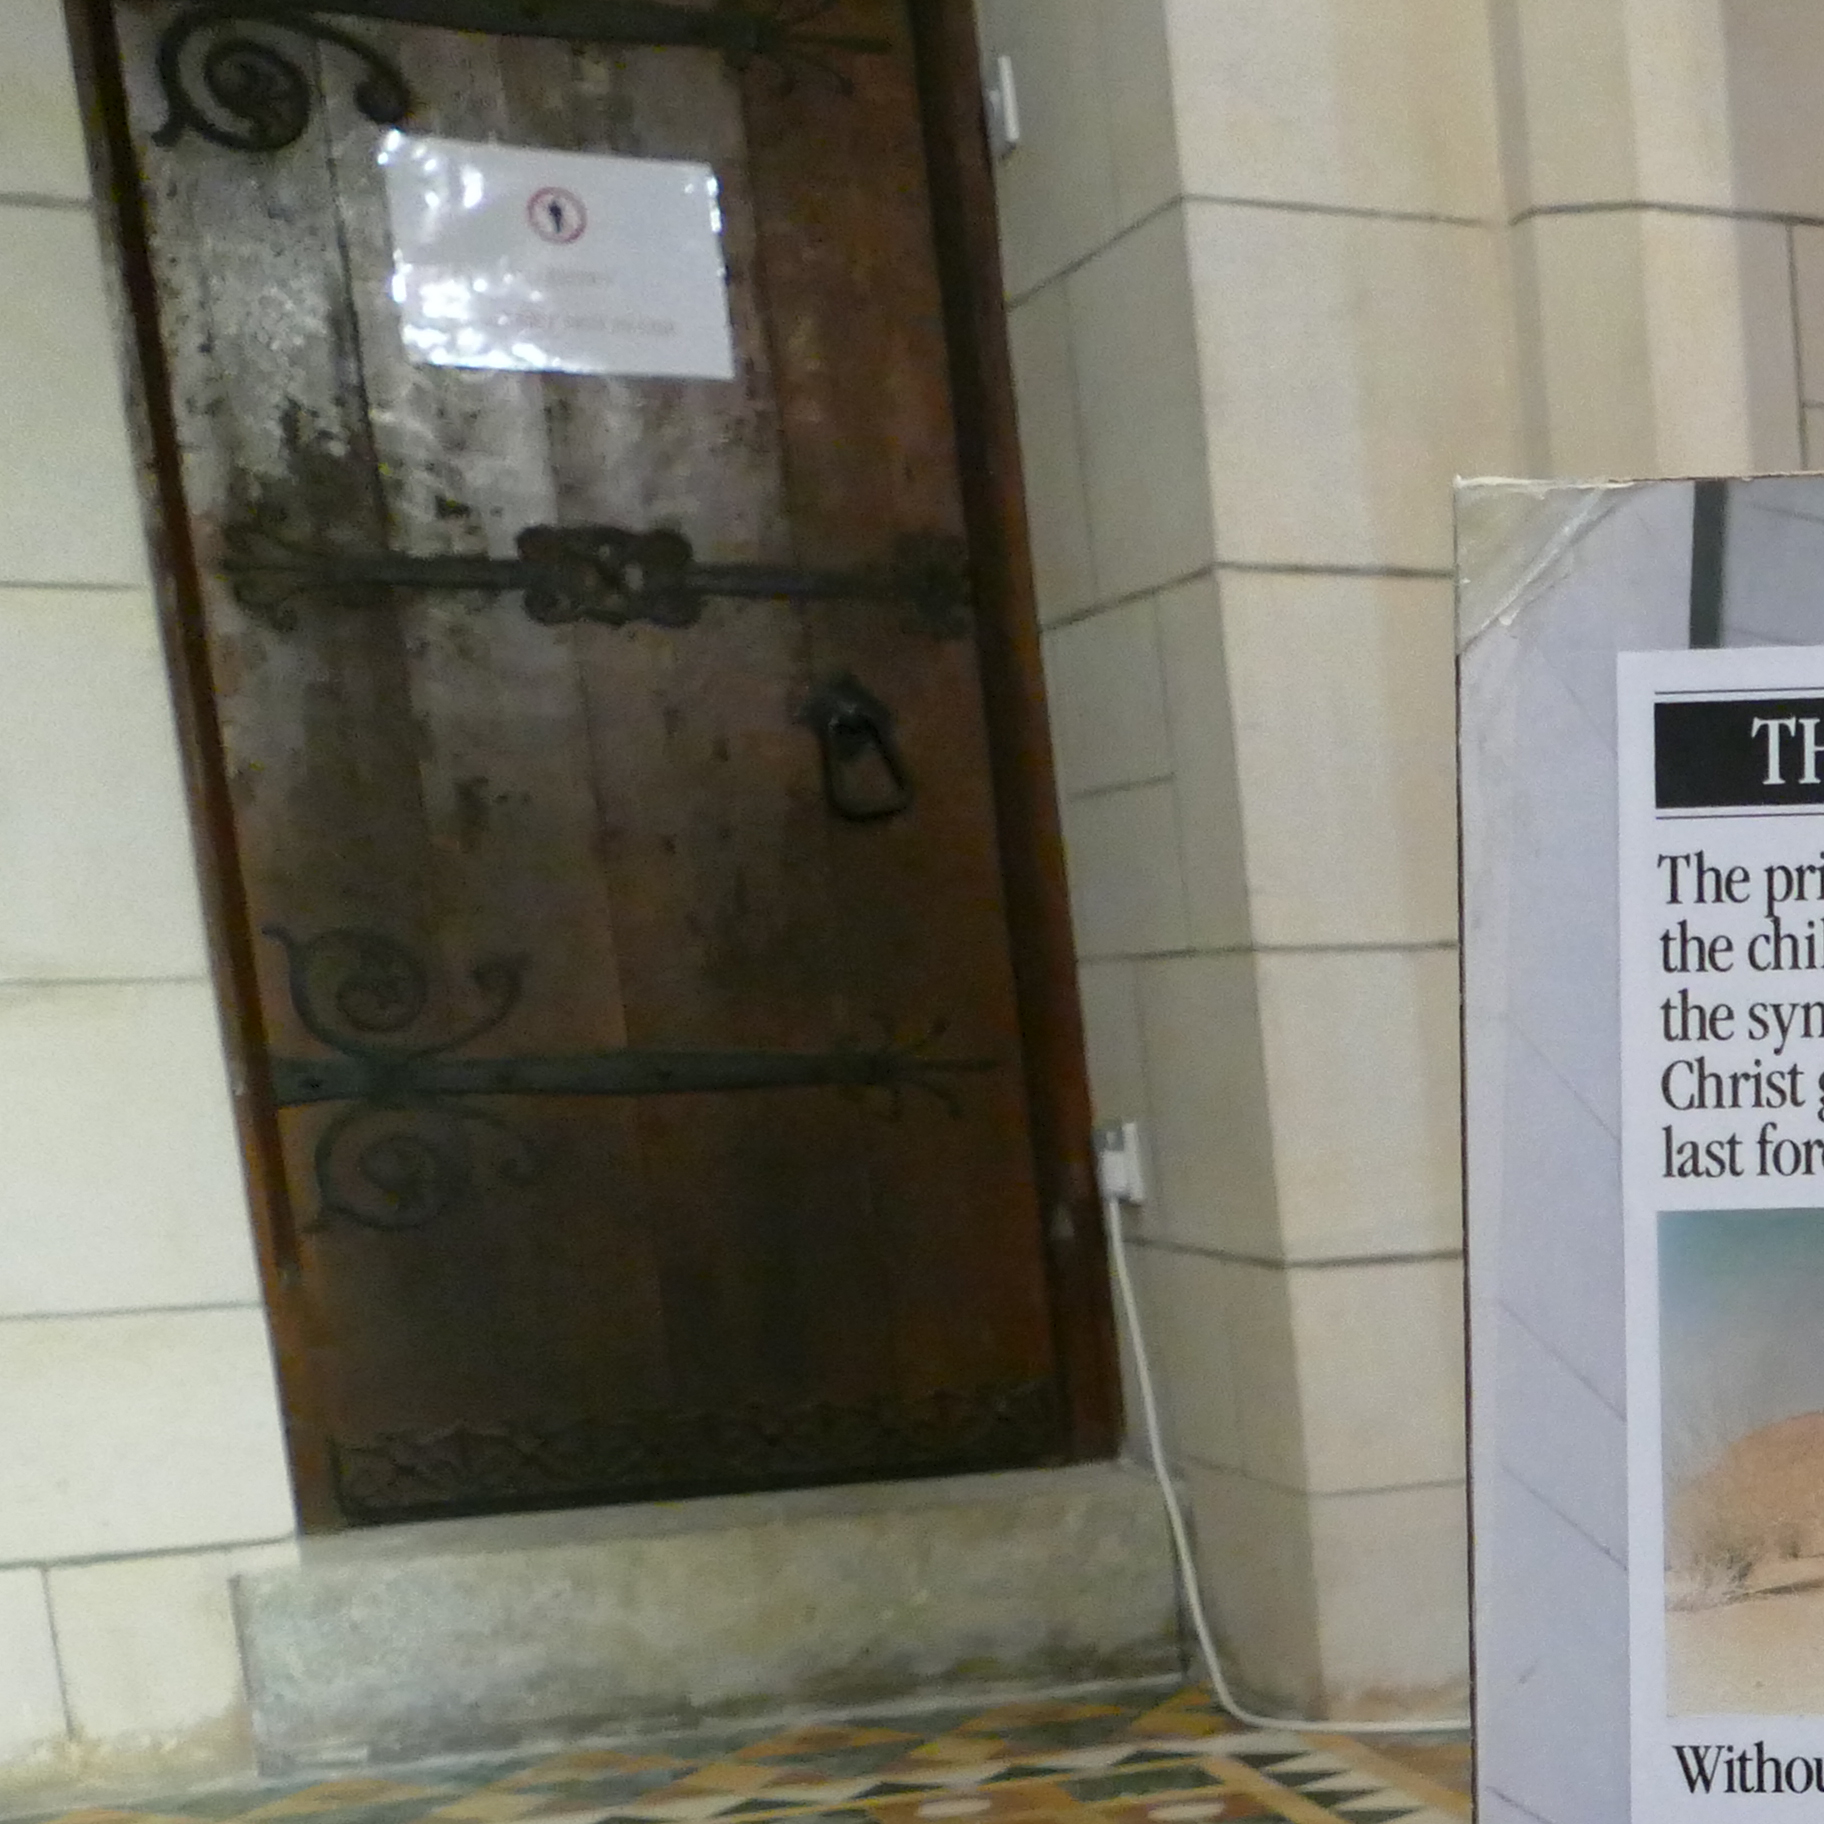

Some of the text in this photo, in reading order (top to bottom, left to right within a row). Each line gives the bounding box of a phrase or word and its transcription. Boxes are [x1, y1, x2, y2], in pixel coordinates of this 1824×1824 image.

[1657, 850, 1750, 905] The
[1659, 919, 1734, 974] the
[1660, 987, 1735, 1042] the
[1661, 1055, 1806, 1111] Christ
[1662, 1124, 1744, 1179] last
